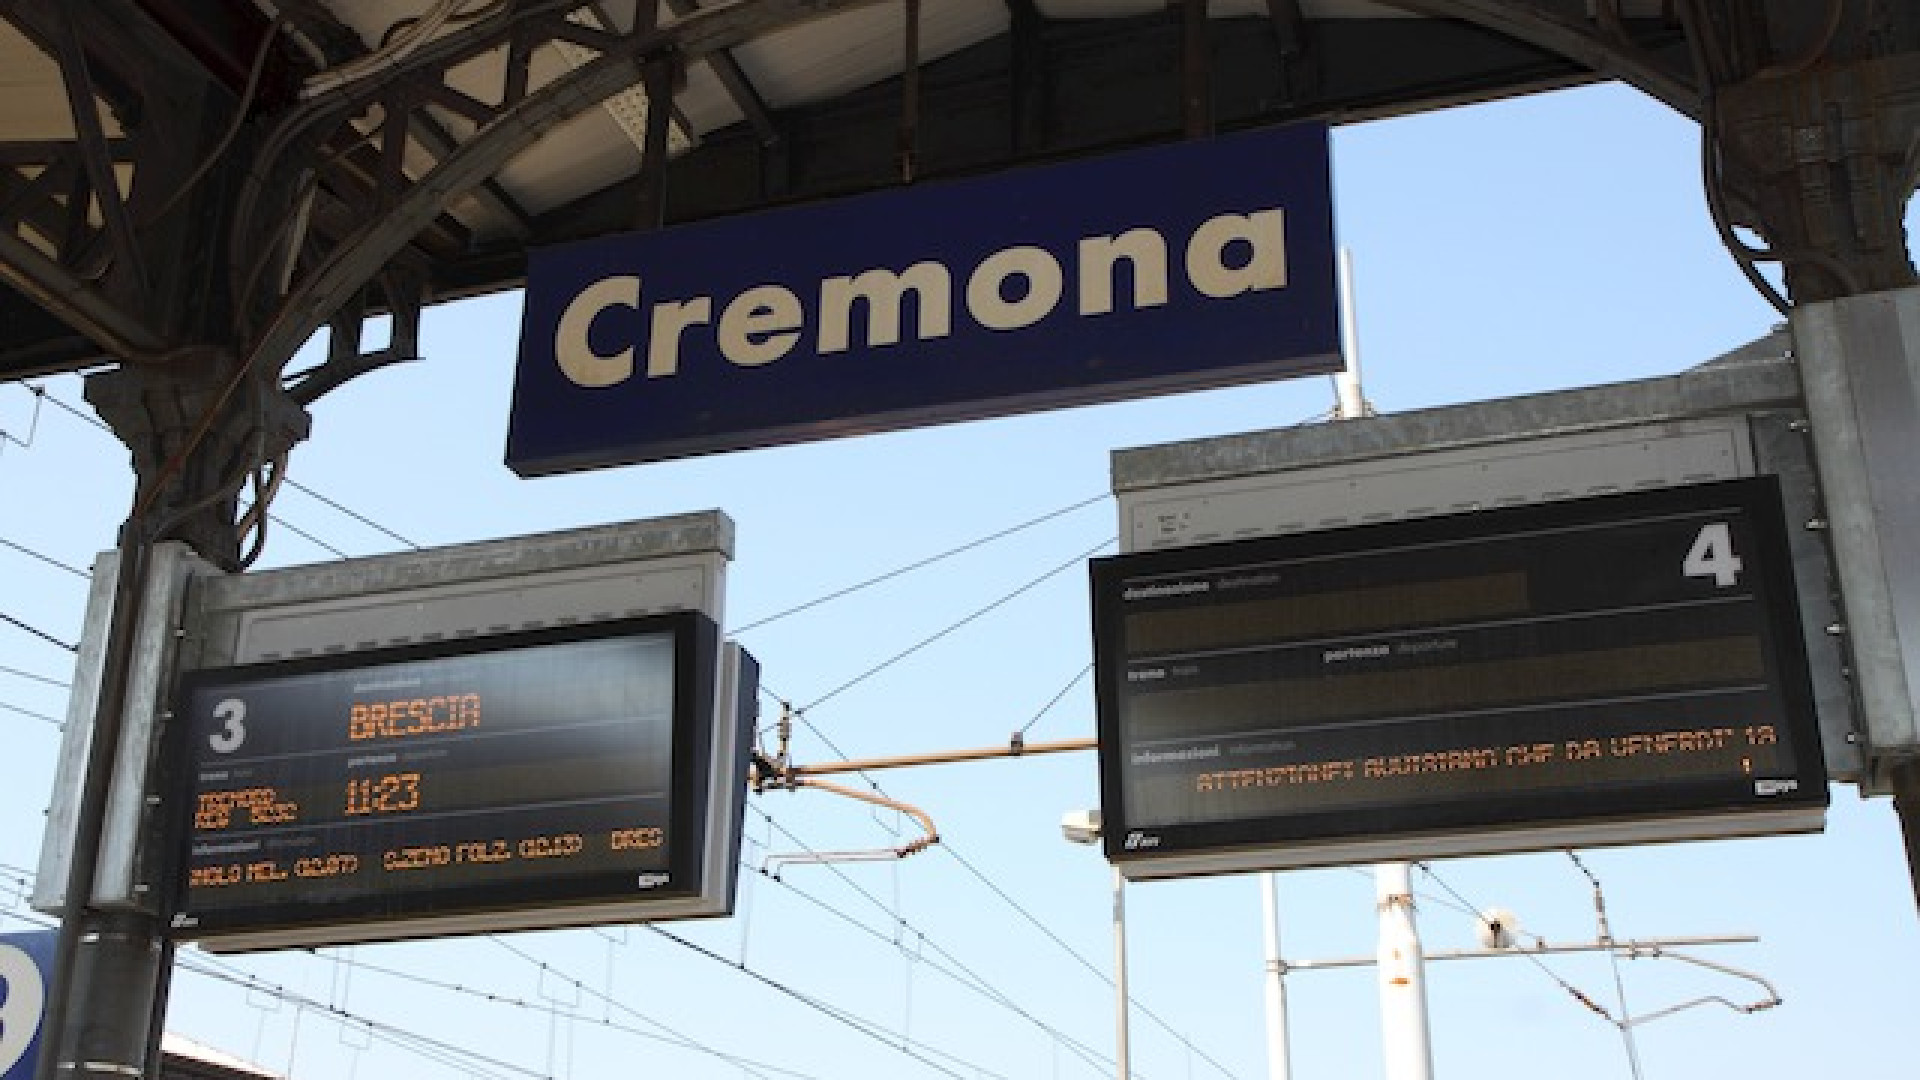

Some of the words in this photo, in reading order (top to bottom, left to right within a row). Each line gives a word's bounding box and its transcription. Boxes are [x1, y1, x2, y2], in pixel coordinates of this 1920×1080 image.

[554, 207, 1288, 388] Cremona
[1683, 523, 1742, 586] 4
[209, 697, 246, 754] 3
[350, 693, 480, 738] BRESCIA
[344, 773, 420, 815] 11:23
